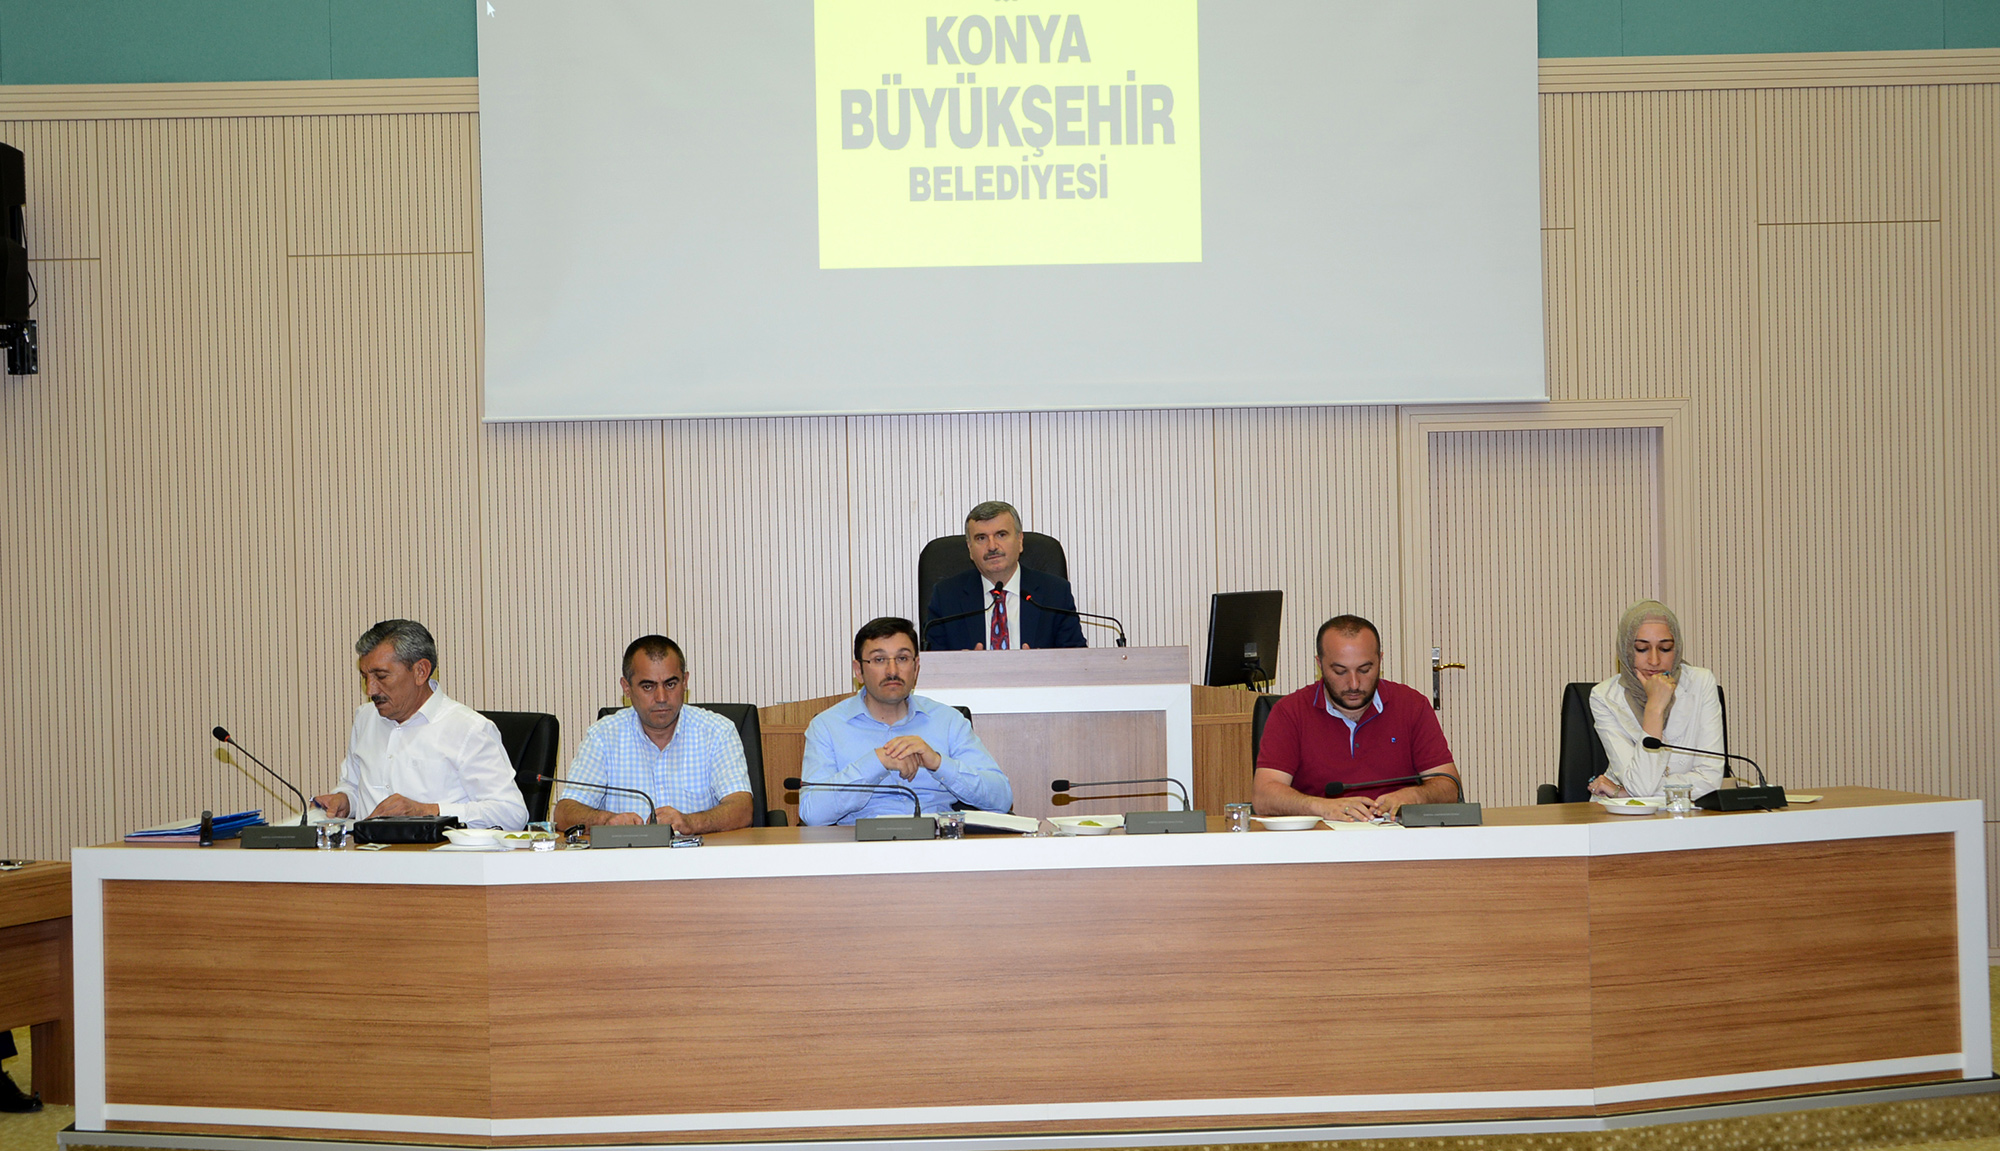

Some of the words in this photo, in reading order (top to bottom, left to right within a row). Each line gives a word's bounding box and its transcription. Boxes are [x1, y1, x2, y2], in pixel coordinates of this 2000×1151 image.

[926, 14, 1091, 65] KONYA
[840, 70, 1176, 158] BÜYÜKŞEHİR
[909, 154, 1108, 202] BELEDİYESİ
